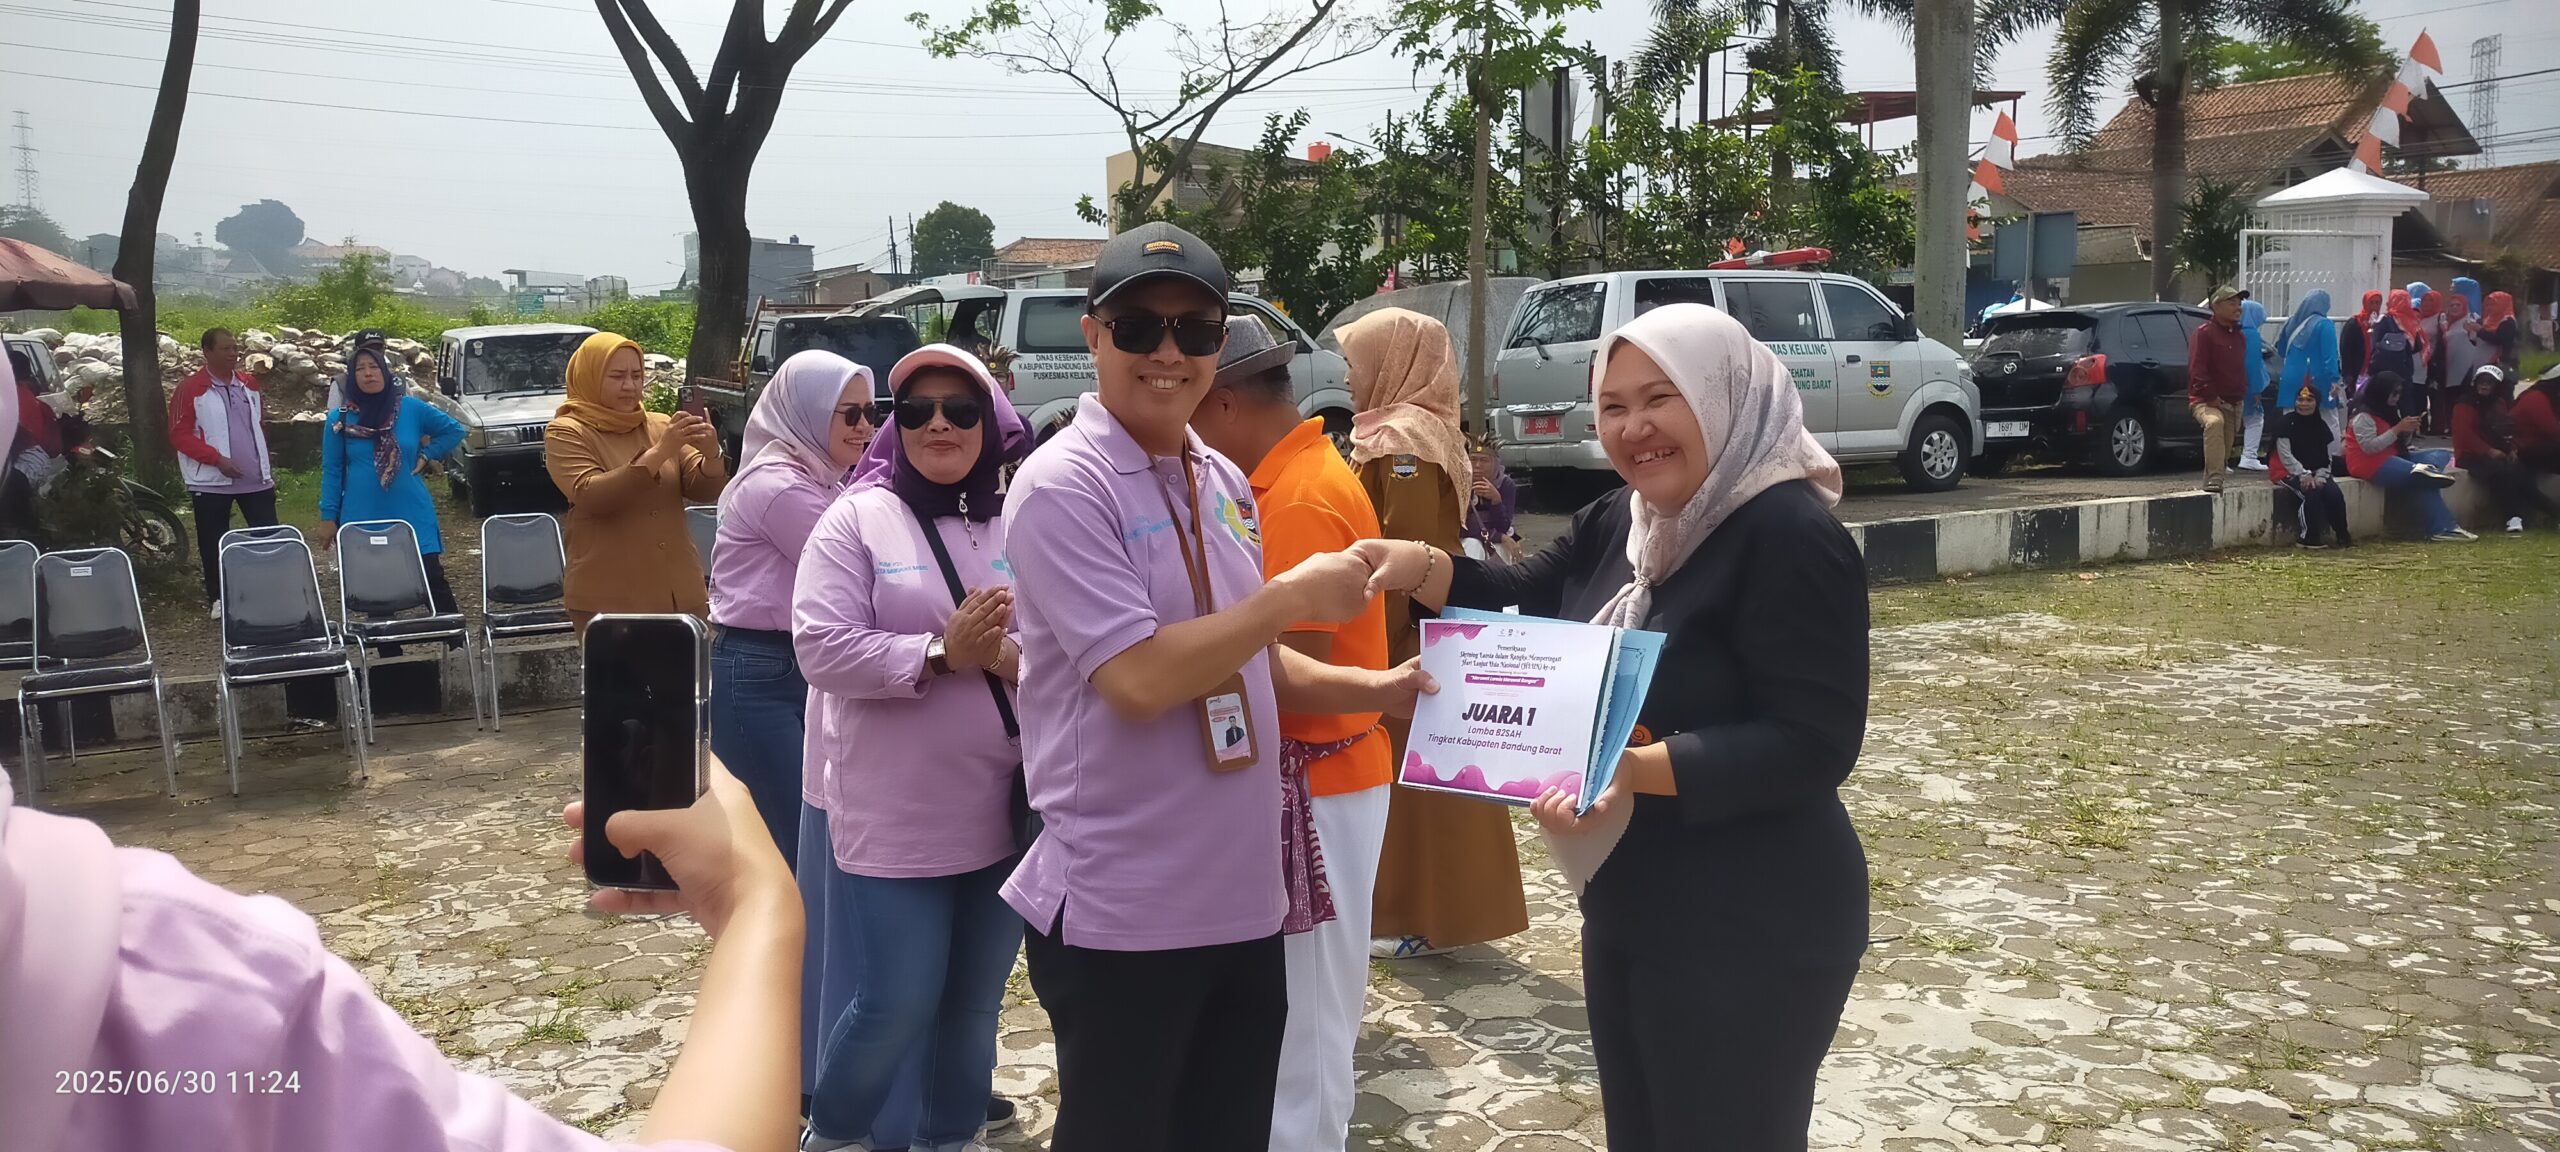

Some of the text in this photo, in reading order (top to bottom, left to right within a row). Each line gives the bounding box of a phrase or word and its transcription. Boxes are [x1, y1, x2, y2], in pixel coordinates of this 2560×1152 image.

[1789, 344, 1827, 355] KELILING
[1033, 372, 1096, 380] PUSKESMAS KELILING
[1789, 368, 1815, 378] EHATAN
[1812, 380, 1832, 390] BARAT
[1462, 703, 1537, 727] JUARA 1
[1468, 725, 1522, 738] Lomba B2SAH
[1428, 732, 1562, 755] Tingkat Kabupaten Bandung Barat
